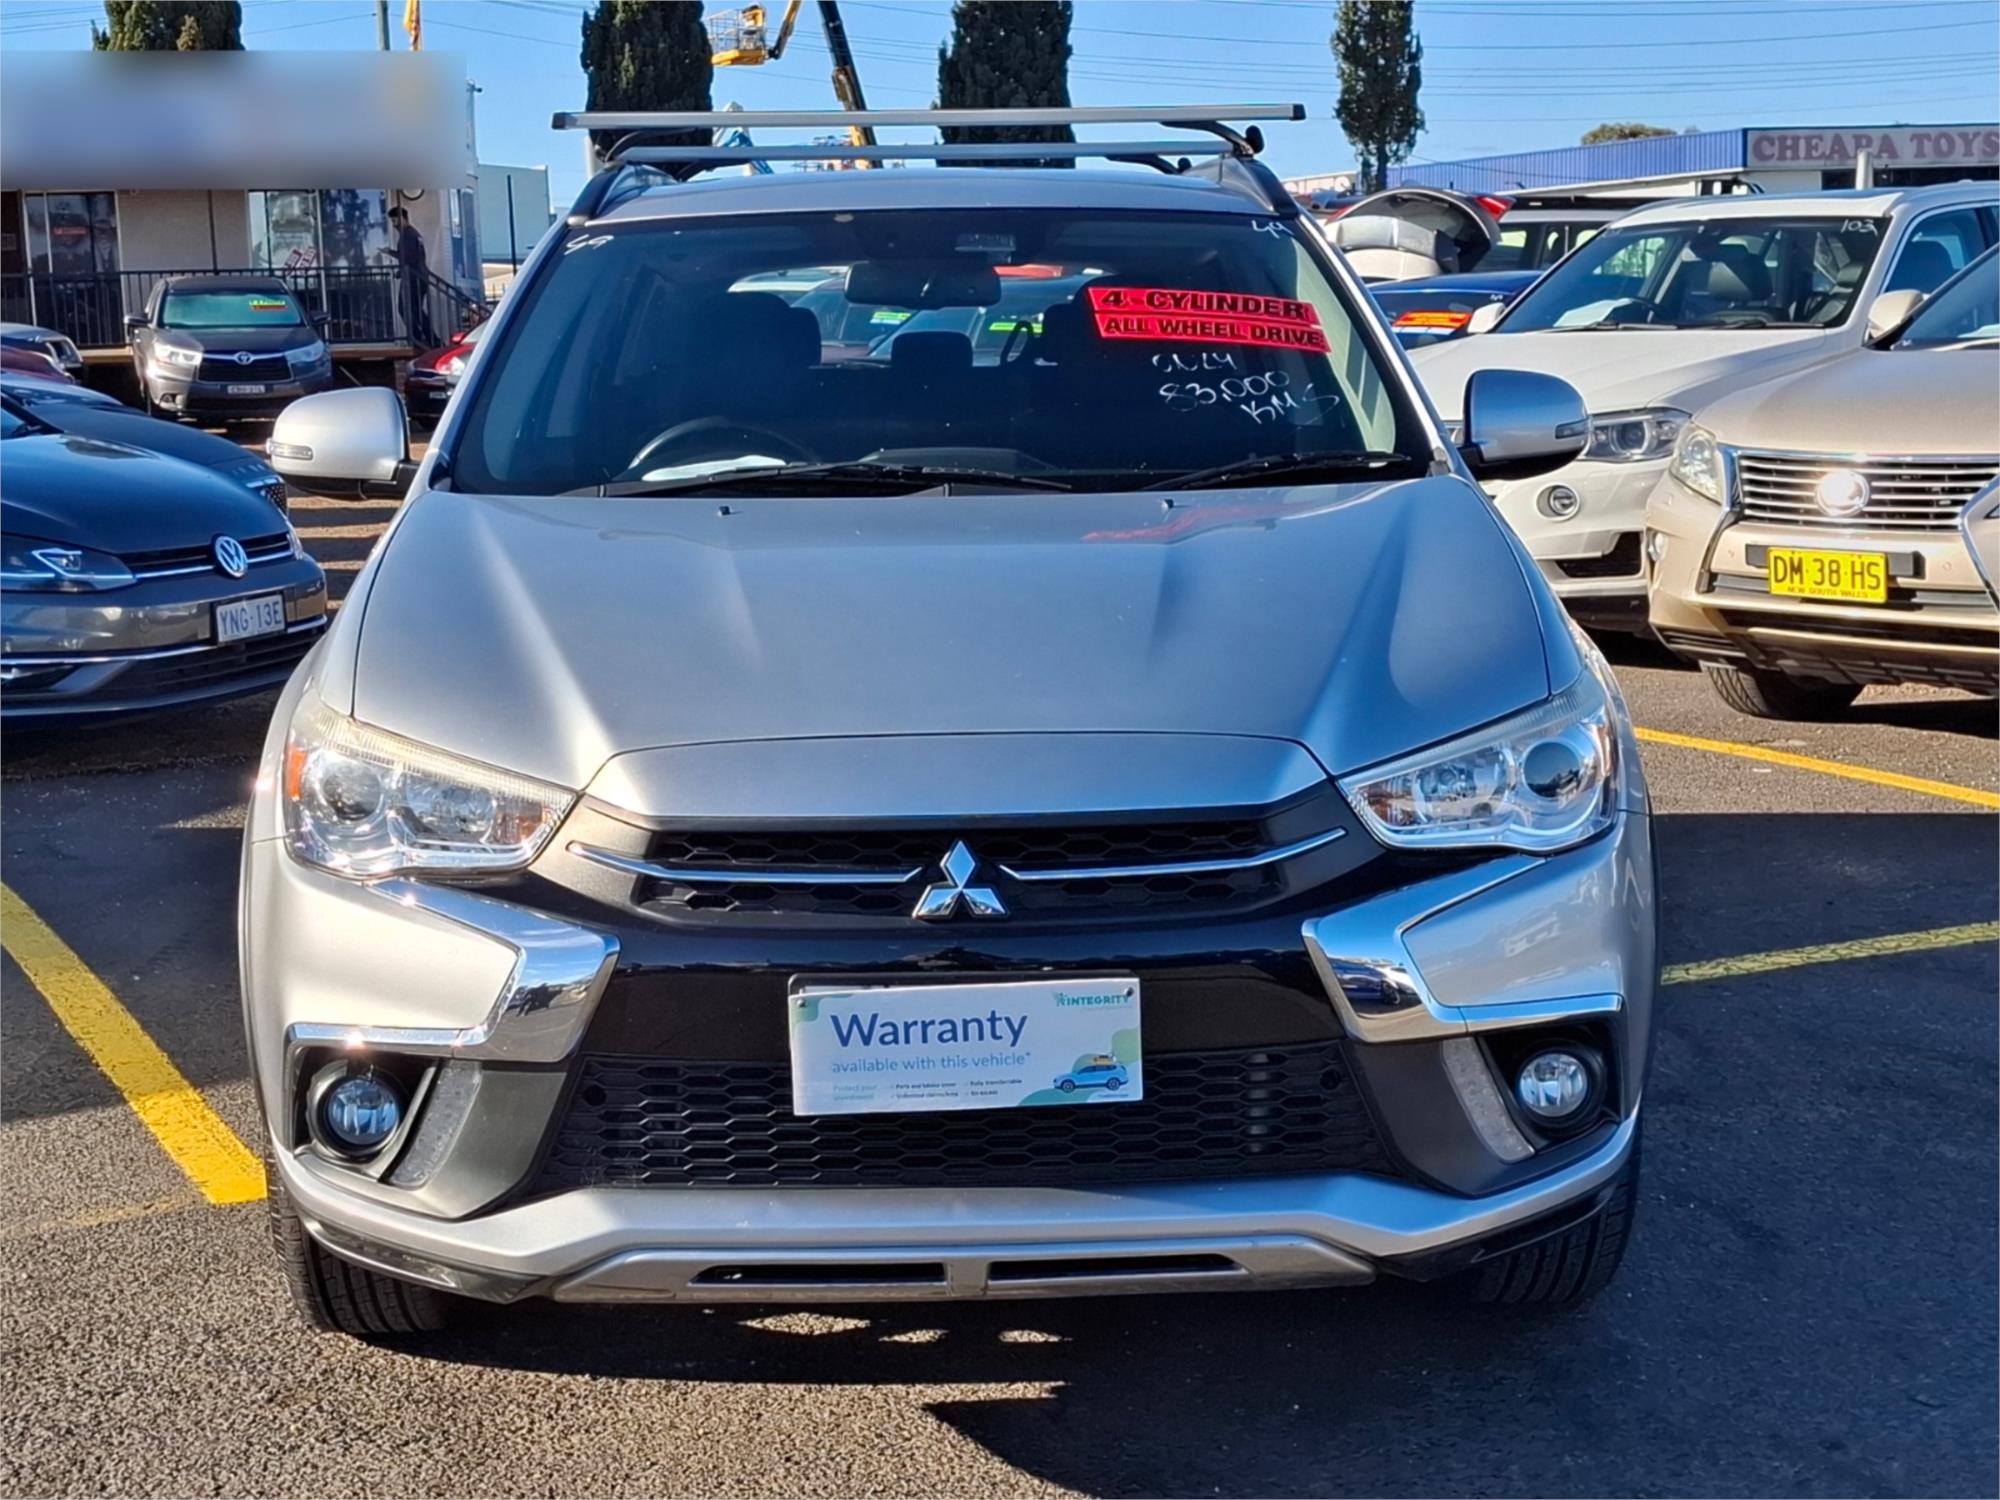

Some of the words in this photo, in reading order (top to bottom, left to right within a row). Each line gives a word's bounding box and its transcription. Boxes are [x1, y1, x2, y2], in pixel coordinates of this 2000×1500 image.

[1910, 131, 1999, 159] TOYS
[1104, 317, 1151, 335] ALL
[1158, 319, 1243, 340] WHEEL
[1251, 324, 1325, 346] DRIVE
[829, 1009, 1028, 1048] Warranty
[831, 1058, 898, 1073] available
[901, 1056, 936, 1070] with
[941, 1054, 969, 1069] this
